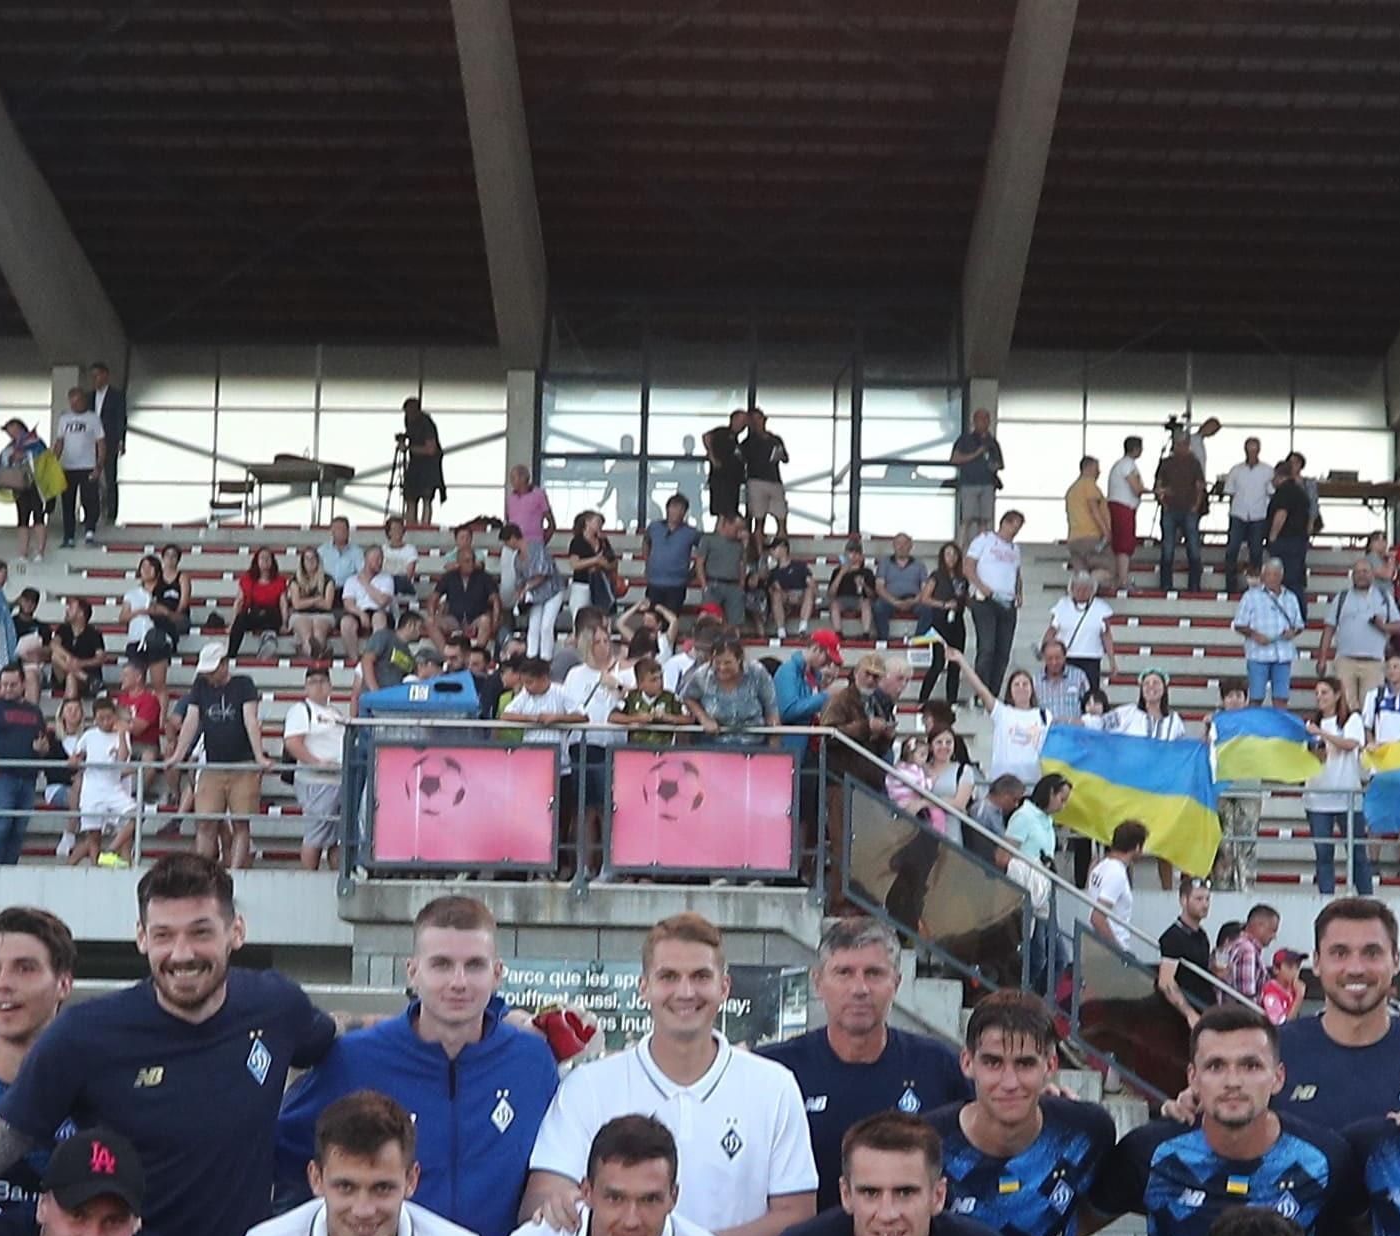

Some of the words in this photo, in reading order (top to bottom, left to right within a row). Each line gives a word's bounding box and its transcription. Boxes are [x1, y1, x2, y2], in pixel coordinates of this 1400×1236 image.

[501, 965, 545, 985] Parce
[549, 970, 581, 989] que
[585, 969, 609, 988] les
[621, 1013, 653, 1032] inut
[89, 1139, 117, 1175] LA
